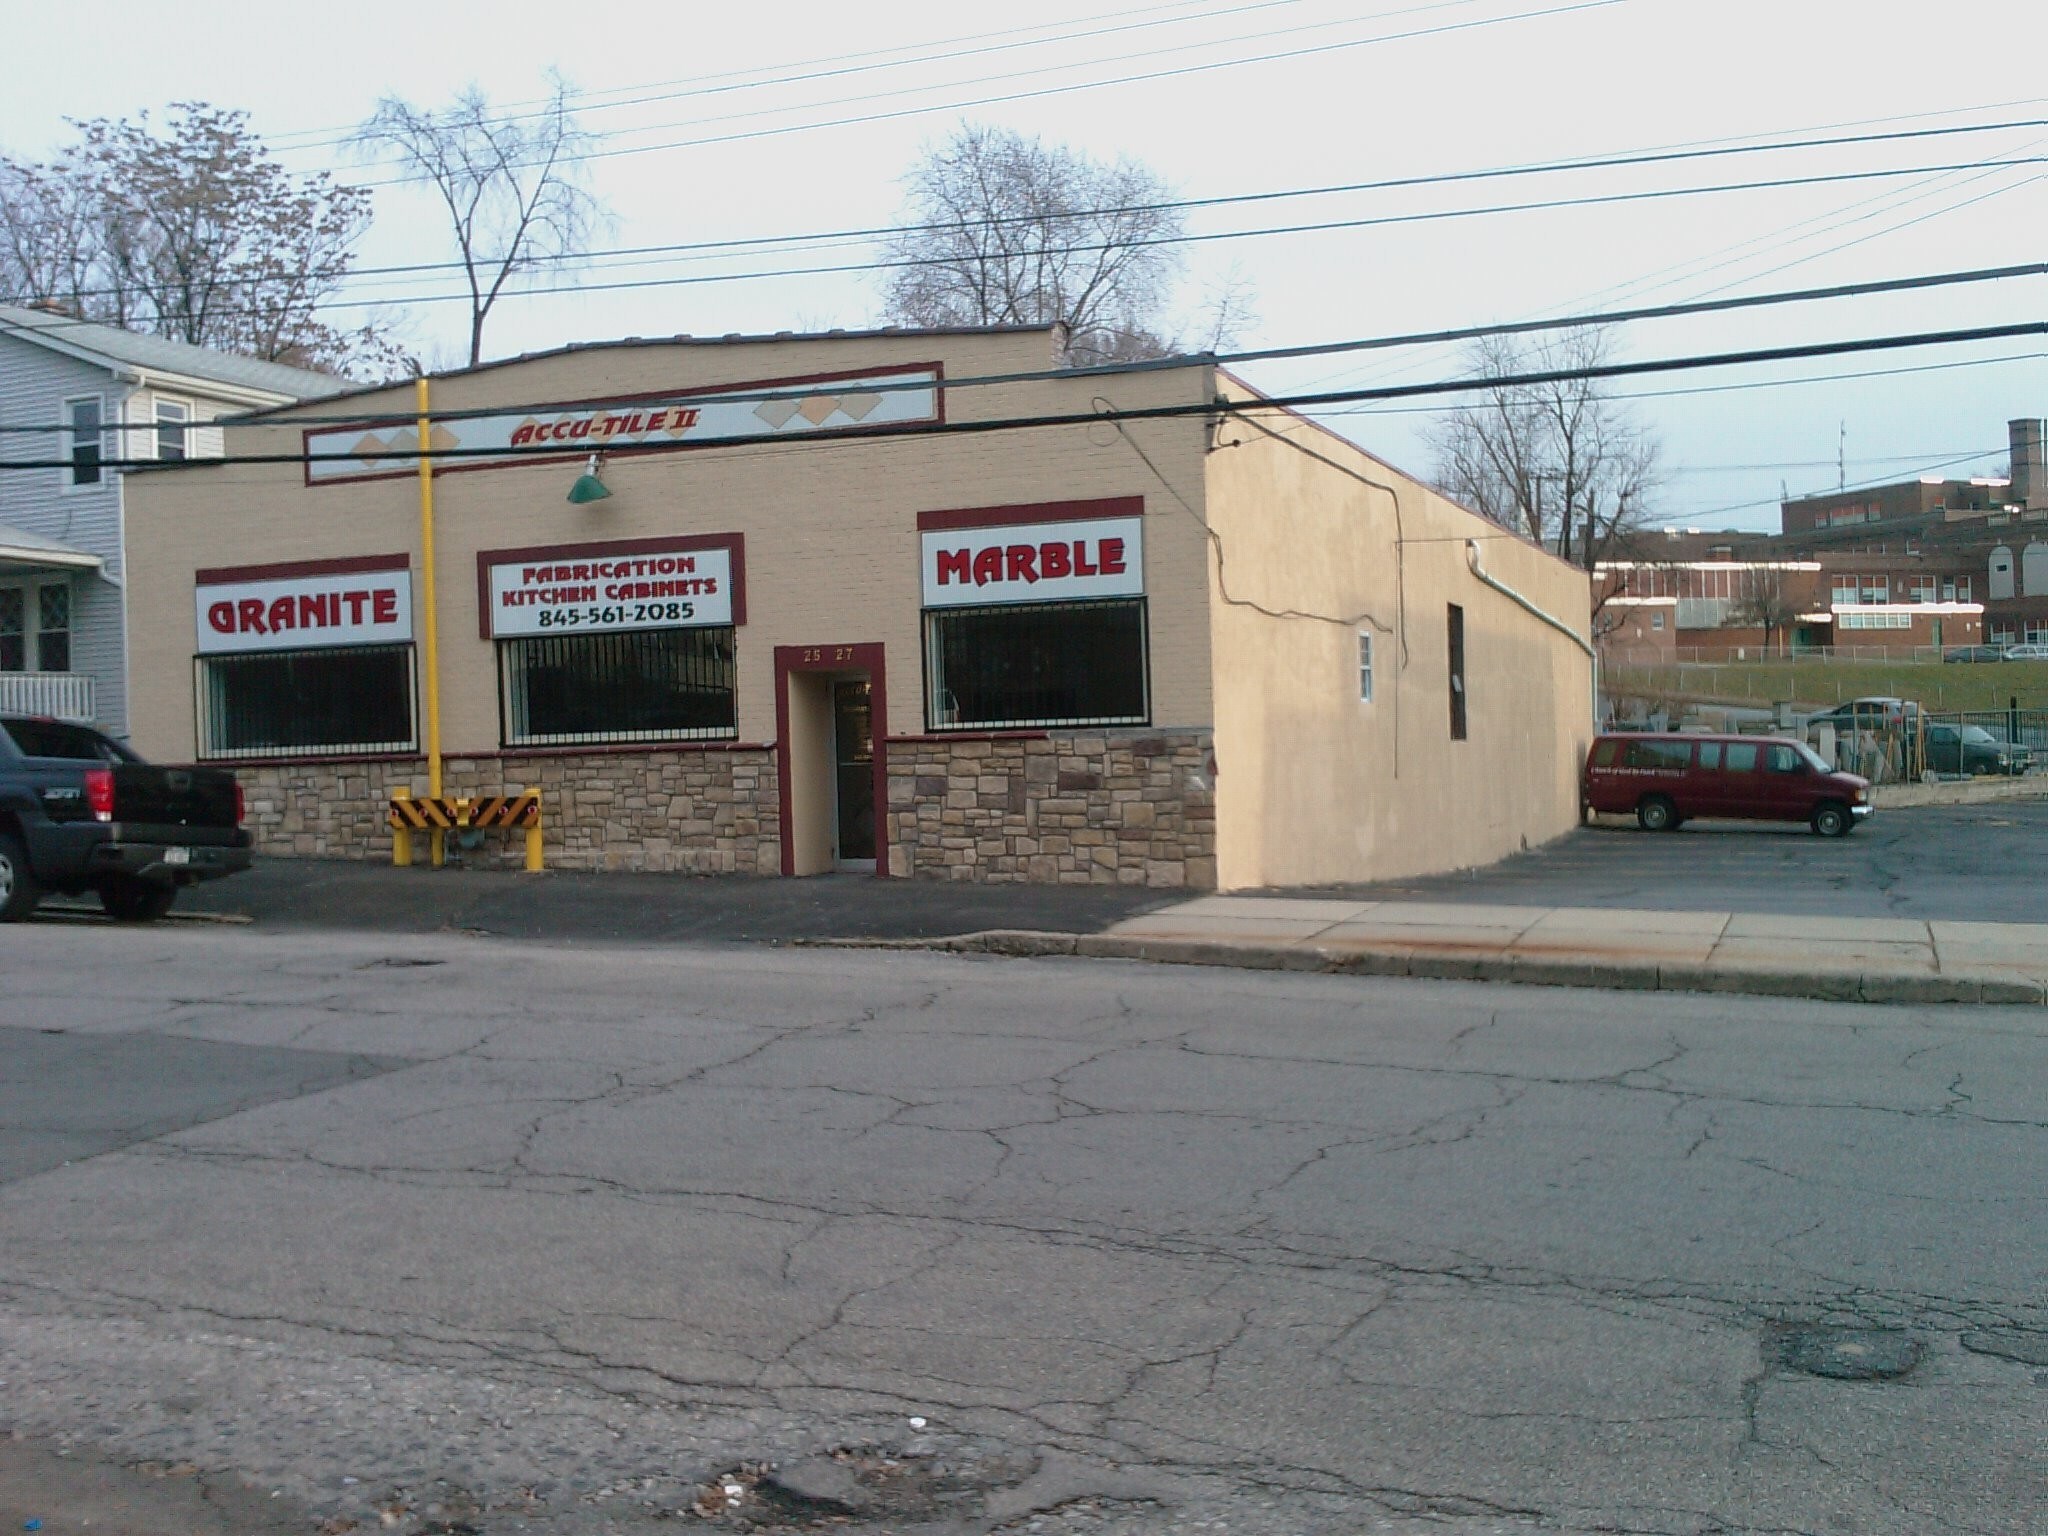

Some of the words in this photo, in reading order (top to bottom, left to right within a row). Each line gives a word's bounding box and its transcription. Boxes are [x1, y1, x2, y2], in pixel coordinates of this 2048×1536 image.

[511, 411, 667, 446] ACCU-TILE
[670, 408, 701, 430] II
[522, 556, 696, 585] FABRICATION
[936, 537, 1127, 587] MARBLE
[502, 585, 597, 607] KITCHEN
[604, 577, 718, 602] CABINETS
[208, 588, 399, 636] GRANITE
[538, 601, 695, 628] 845-561-2085
[804, 649, 821, 663] 25
[836, 647, 854, 661] 27
